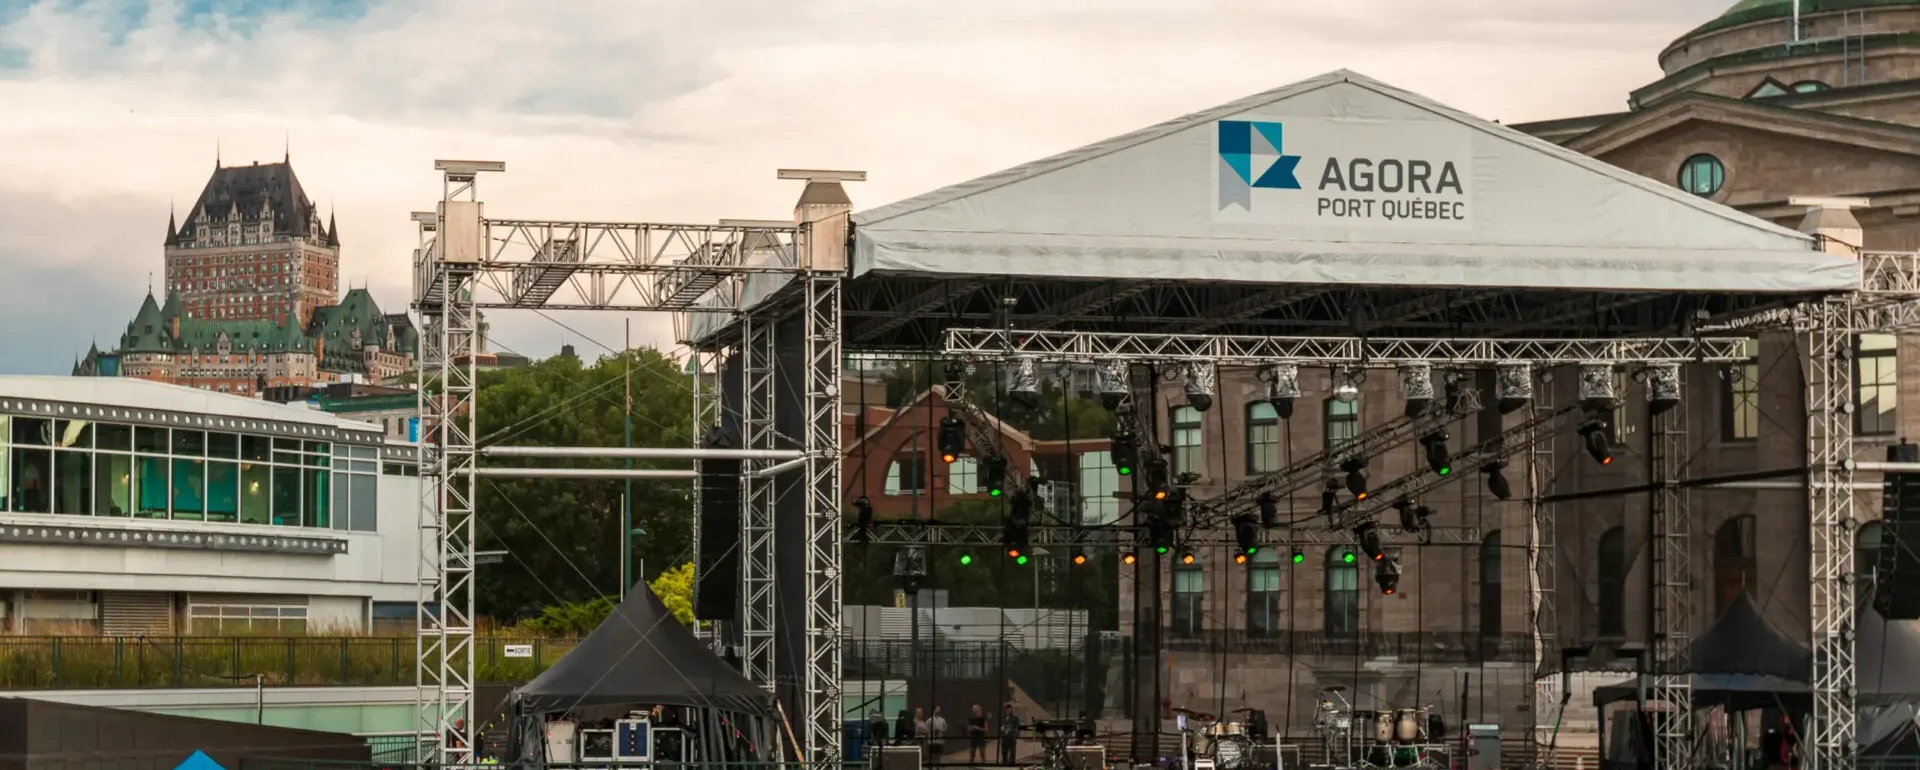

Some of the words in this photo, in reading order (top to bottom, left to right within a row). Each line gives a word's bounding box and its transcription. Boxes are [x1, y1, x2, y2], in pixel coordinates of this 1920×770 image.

[1318, 157, 1463, 194] AGORA
[1318, 198, 1375, 218] PORT
[1382, 197, 1464, 220] QUÉBEC
